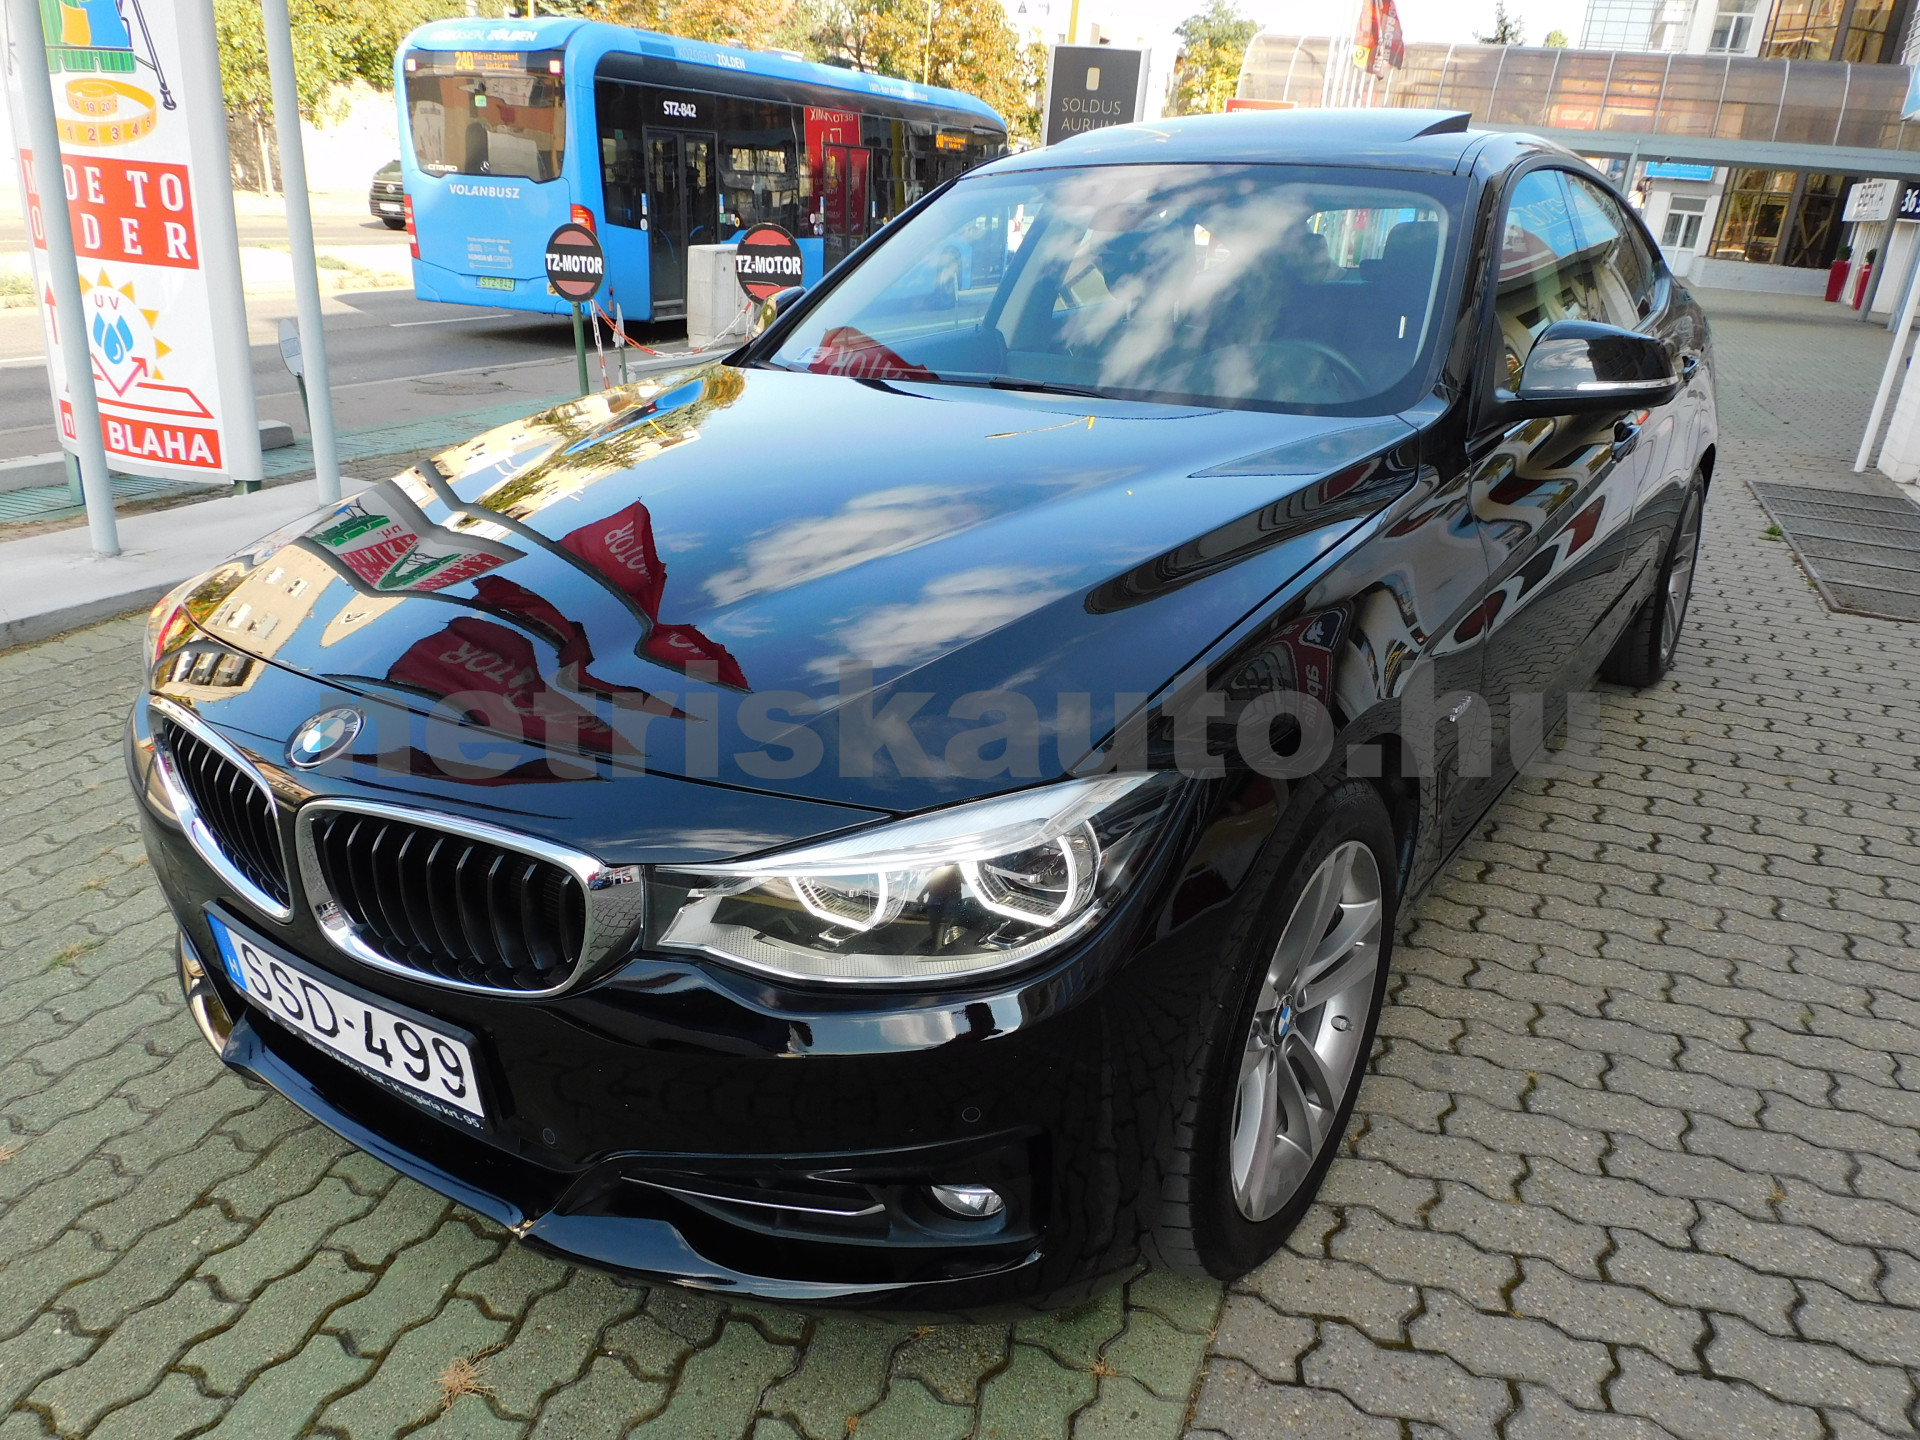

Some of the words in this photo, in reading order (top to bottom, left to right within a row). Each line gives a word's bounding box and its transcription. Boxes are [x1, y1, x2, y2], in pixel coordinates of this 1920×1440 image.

[455, 51, 474, 70] 240
[86, 103, 95, 113] 19
[101, 103, 111, 112] 20
[663, 100, 697, 118] STZ-842
[1061, 97, 1121, 116] SOLDUS
[87, 128, 96, 142] 2
[111, 127, 120, 140] 3
[132, 122, 139, 135] 4
[24, 159, 105, 204] MDE
[126, 169, 185, 212] TO
[31, 205, 192, 260] ODER
[545, 253, 604, 275] TZ-MOTOR
[735, 254, 801, 275] TZ-MOTOR
[107, 420, 215, 464] BLAHA
[241, 943, 466, 1099] SSD-499
[463, 1114, 485, 1130] 95.
